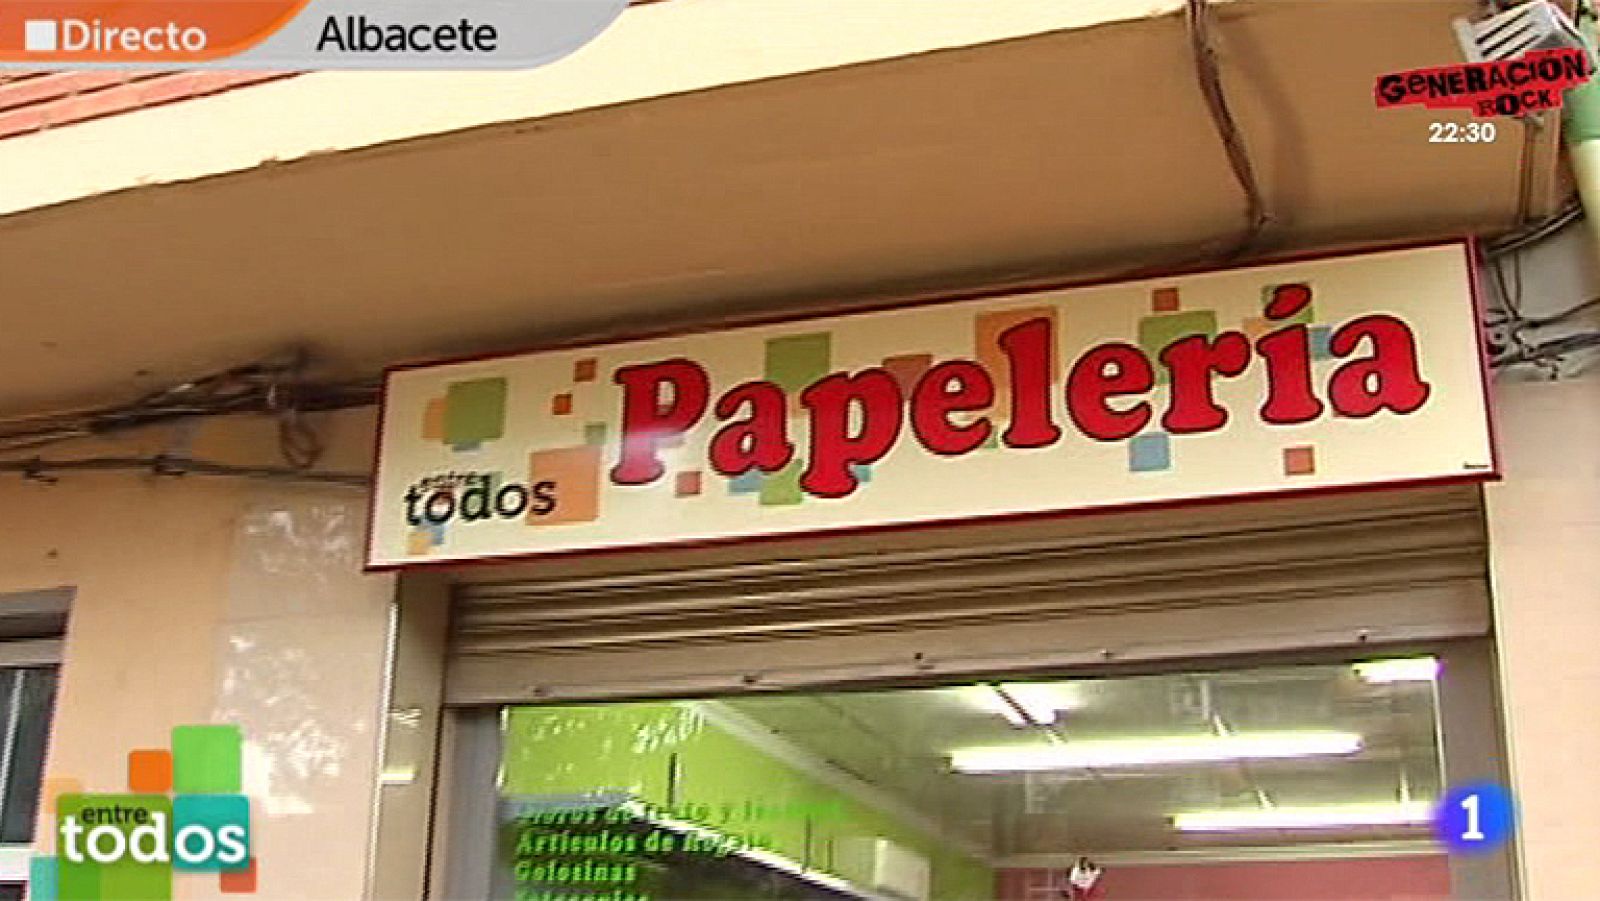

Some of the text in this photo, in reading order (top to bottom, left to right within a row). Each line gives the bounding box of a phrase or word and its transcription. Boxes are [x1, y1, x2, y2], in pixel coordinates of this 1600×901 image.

[610, 283, 1430, 498] Papelería
[404, 475, 557, 525] todos
[645, 829, 675, 853] de
[515, 858, 637, 881] Golosinas
